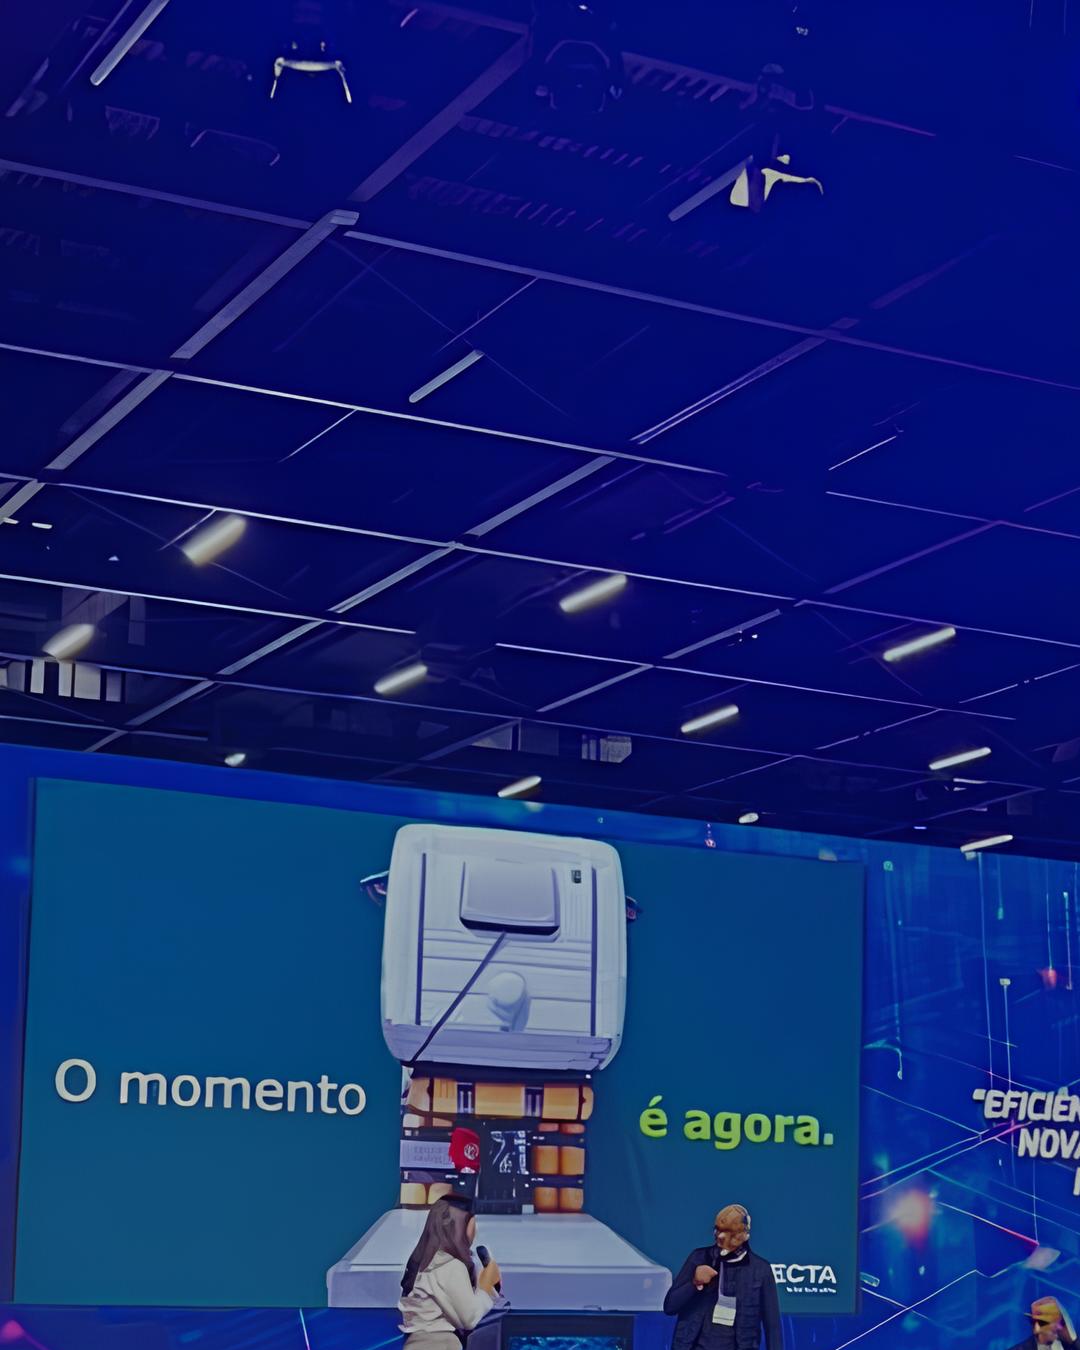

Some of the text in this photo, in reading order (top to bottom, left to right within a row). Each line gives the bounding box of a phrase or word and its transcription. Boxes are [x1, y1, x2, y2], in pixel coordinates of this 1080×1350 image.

[55, 1058, 367, 1116] O momento
[639, 1094, 834, 1150] é agora.
